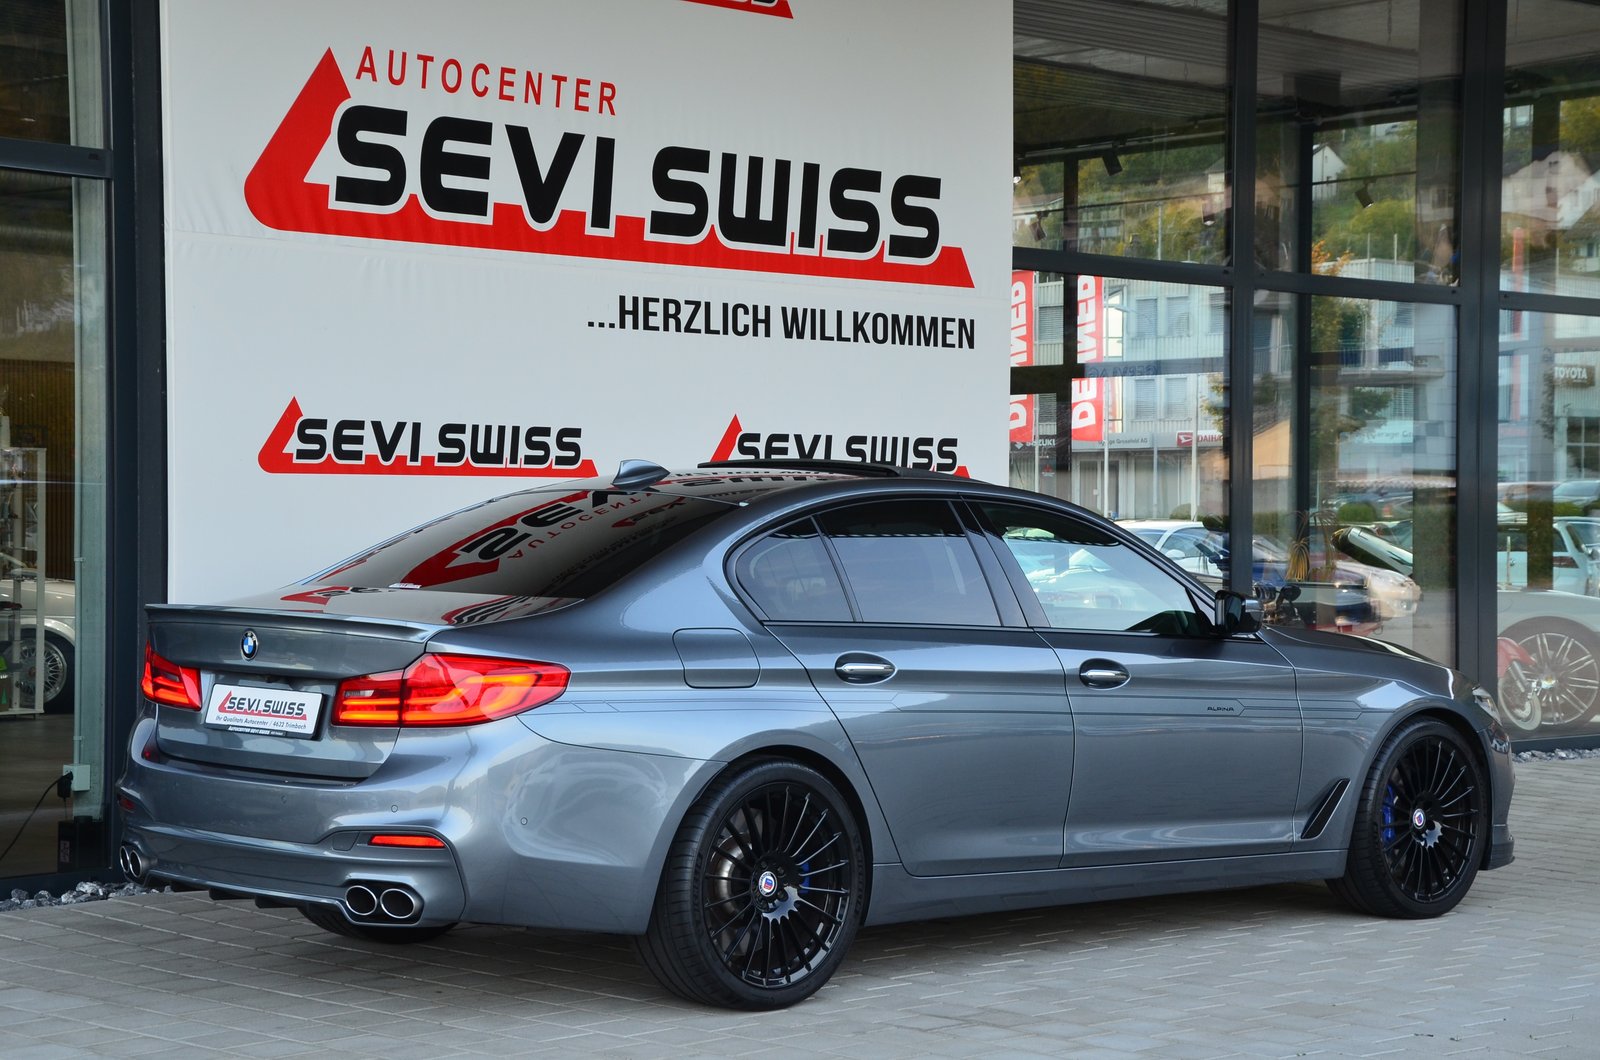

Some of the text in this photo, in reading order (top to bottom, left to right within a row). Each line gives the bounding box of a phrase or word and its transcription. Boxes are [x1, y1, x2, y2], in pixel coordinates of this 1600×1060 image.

[355, 46, 617, 116] AUTOCENTER
[334, 104, 942, 259] SEVI SWISS
[781, 306, 976, 350] WILLKOMMEN
[1553, 366, 1588, 379] TOYOTA
[295, 418, 583, 466] SEVI SWISS
[737, 432, 959, 472] SEVI SWISS
[227, 697, 306, 716] SEVI SWISS
[244, 717, 269, 726] Autocenter
[285, 722, 307, 730] Trimbach
